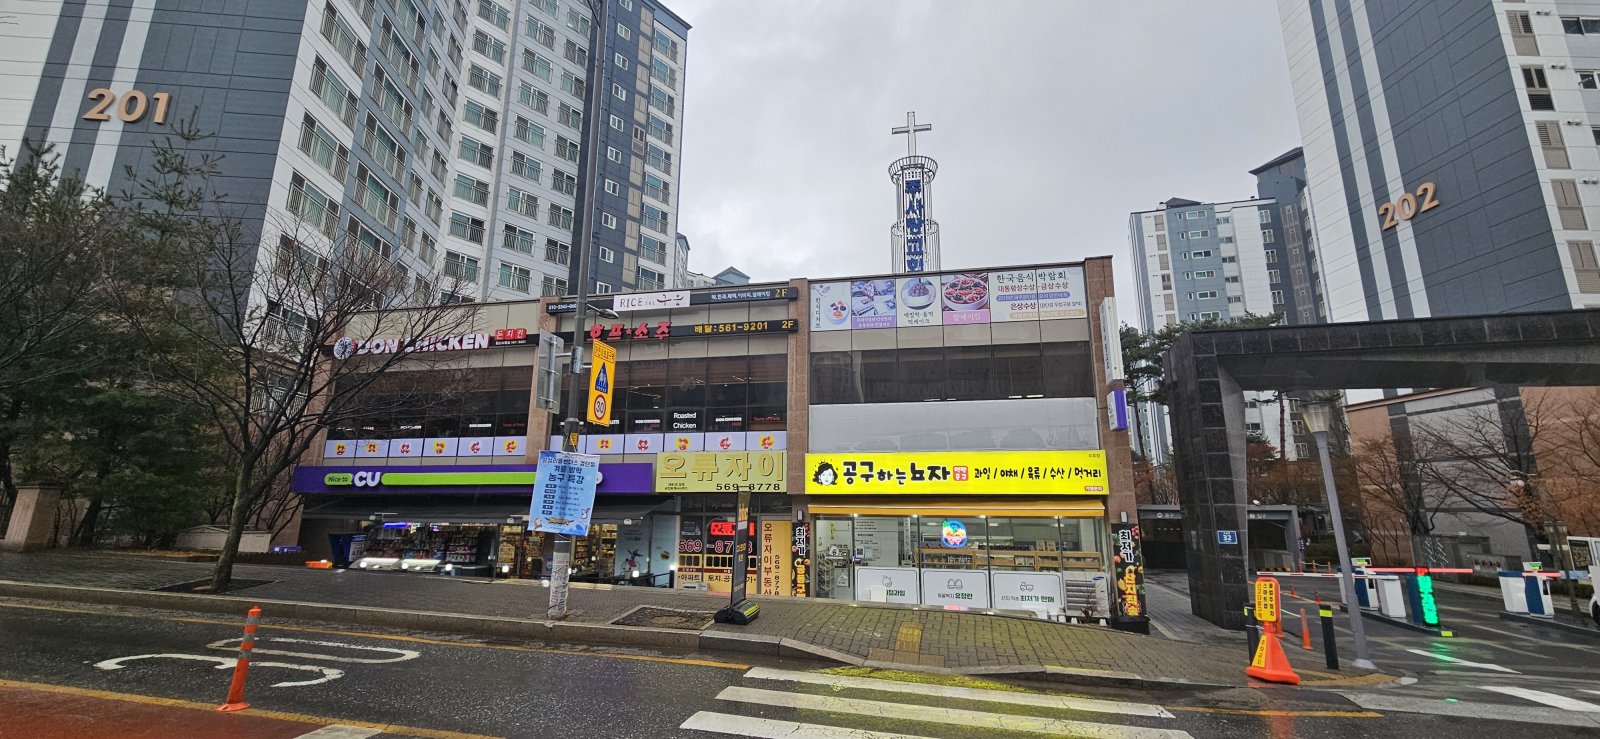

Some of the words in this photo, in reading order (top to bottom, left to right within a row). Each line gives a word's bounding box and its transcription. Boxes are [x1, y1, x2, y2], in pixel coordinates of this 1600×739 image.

[82, 89, 171, 126] 201
[1378, 182, 1440, 231] 202
[996, 272, 1034, 284] 한국음식
[1038, 271, 1067, 281] 박람회
[775, 288, 788, 298] 2F
[998, 284, 1035, 293] 대통령상수상
[620, 297, 643, 308] RICE
[1010, 303, 1037, 311] 은상수상
[694, 321, 769, 333] 배달:561-9201
[781, 320, 794, 329] 2F
[495, 329, 527, 340] 돈치킨
[356, 338, 400, 355] DON
[404, 333, 491, 353] CHICKEN
[596, 402, 605, 414] 30
[554, 465, 567, 473] 겨울
[568, 466, 583, 475] 방학
[659, 452, 785, 482] 오류자이
[974, 467, 991, 479] 과일
[1000, 468, 1018, 478] 야채
[1028, 466, 1041, 480] 육류
[1049, 467, 1065, 480] 수산
[1074, 467, 1102, 480] 먹거리
[353, 471, 381, 487] CU
[548, 473, 565, 483] 농구
[568, 474, 585, 485] 특강
[678, 540, 703, 553] 569
[1119, 530, 1135, 562] 최저가
[763, 522, 773, 596] 오류자이부동산
[955, 592, 973, 600] 유정란
[1041, 595, 1055, 603] 판매
